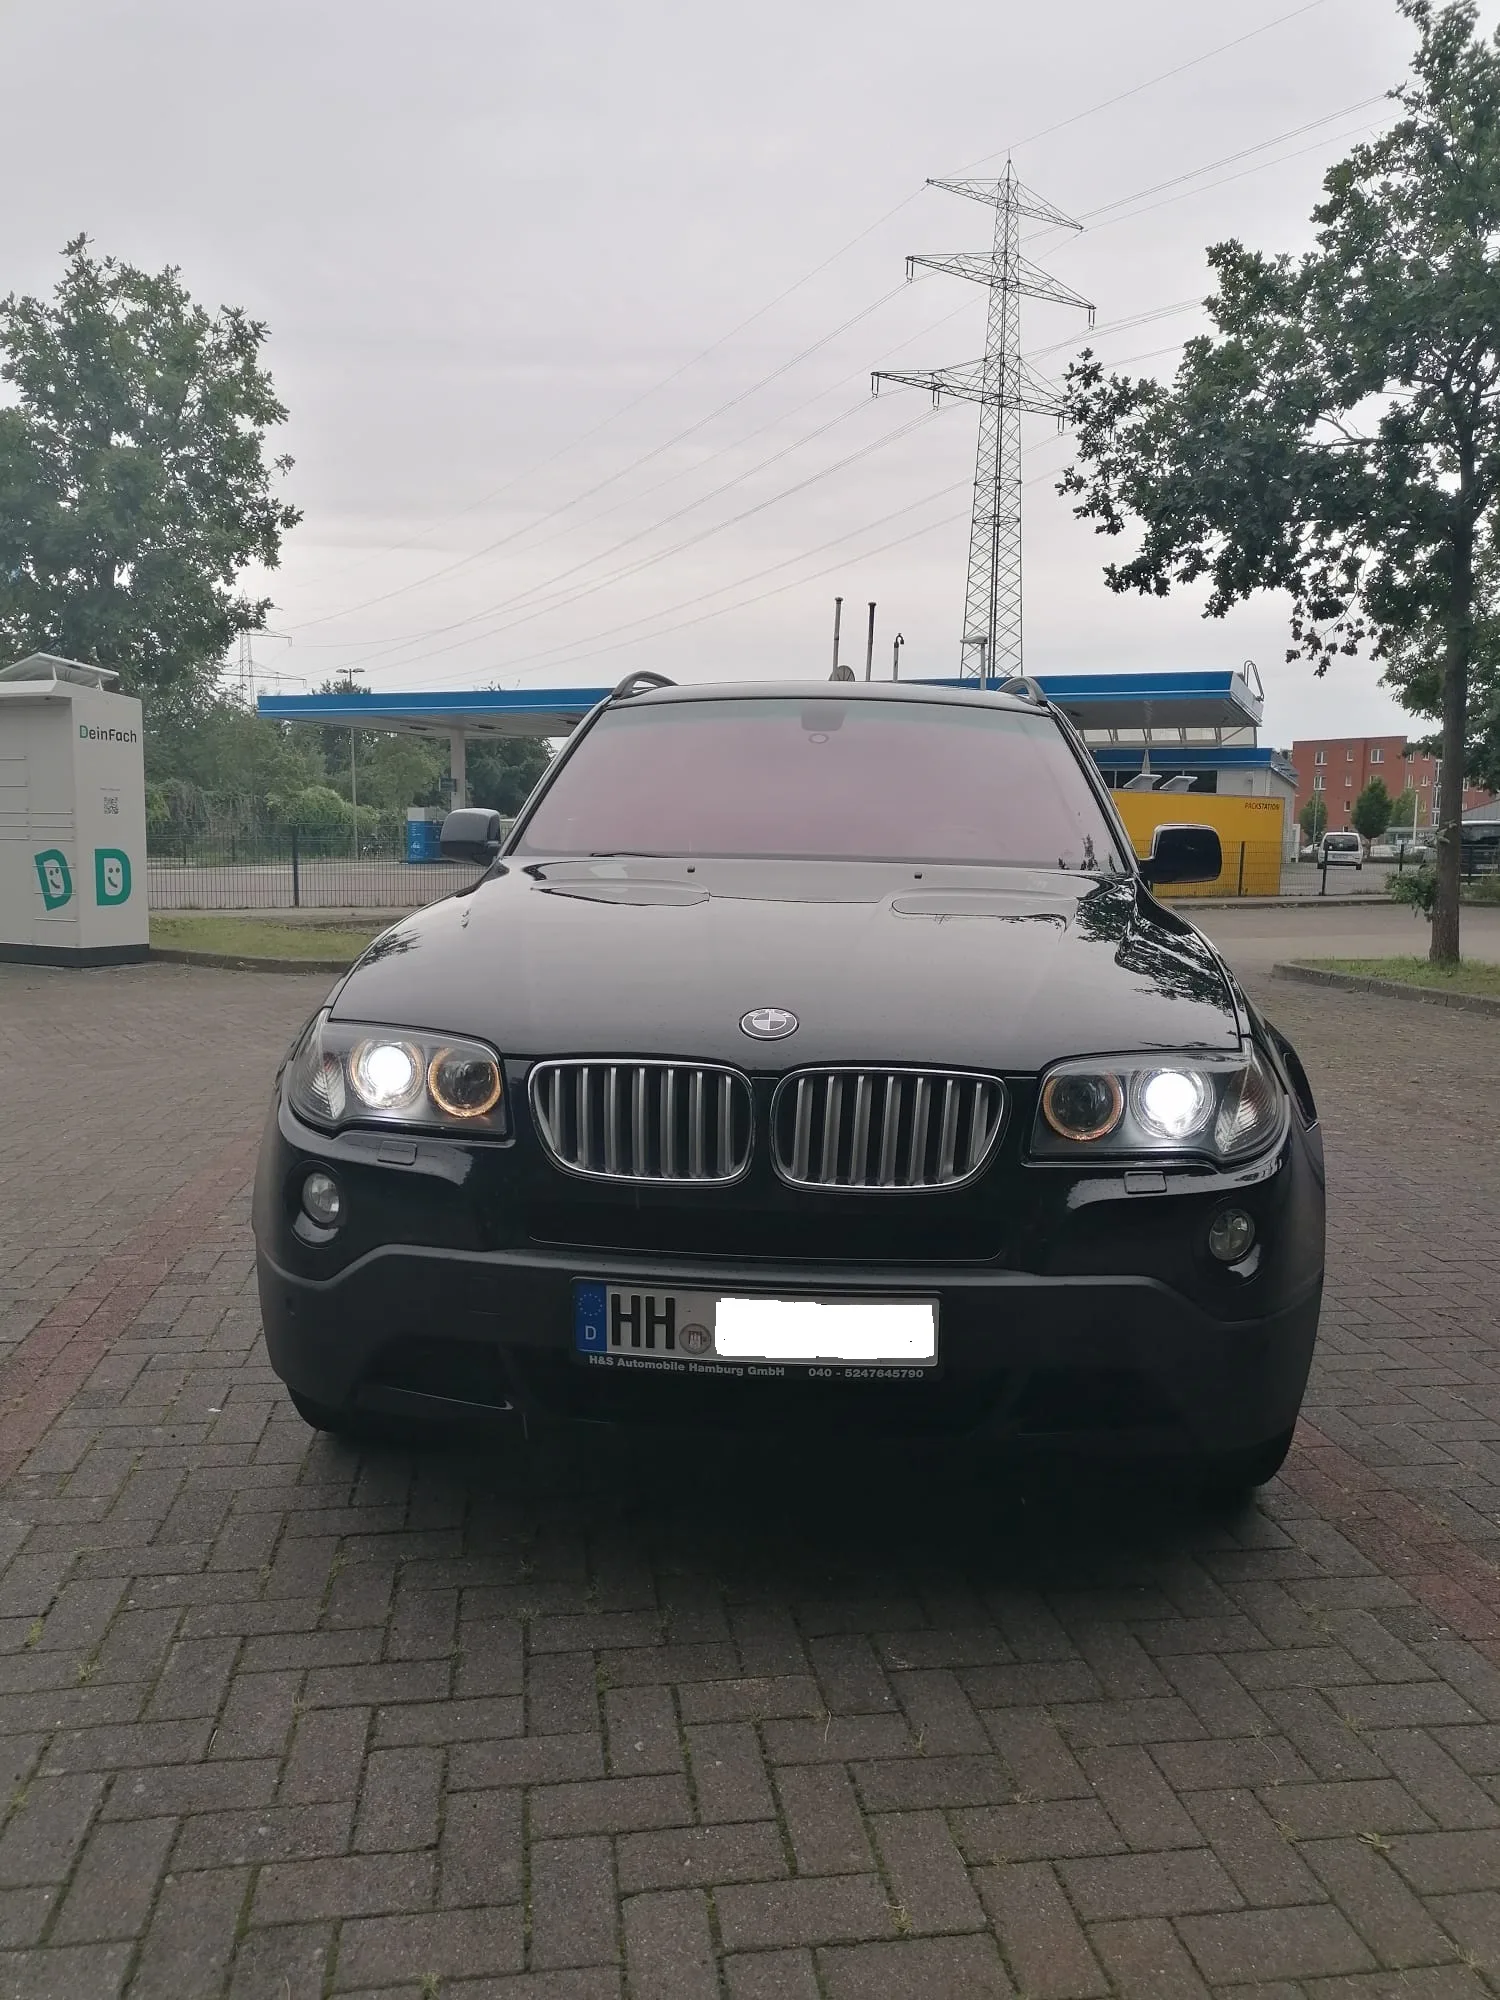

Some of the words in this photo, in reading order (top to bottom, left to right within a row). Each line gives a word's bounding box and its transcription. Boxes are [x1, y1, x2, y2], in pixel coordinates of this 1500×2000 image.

[79, 725, 137, 743] DeinFach
[611, 1293, 675, 1350] HH
[585, 1325, 597, 1340] D
[589, 1355, 614, 1366] H&S
[617, 1358, 686, 1371] Automobile
[688, 1363, 744, 1376] Hamburg
[747, 1366, 785, 1376] GmbH
[808, 1368, 832, 1377] 040
